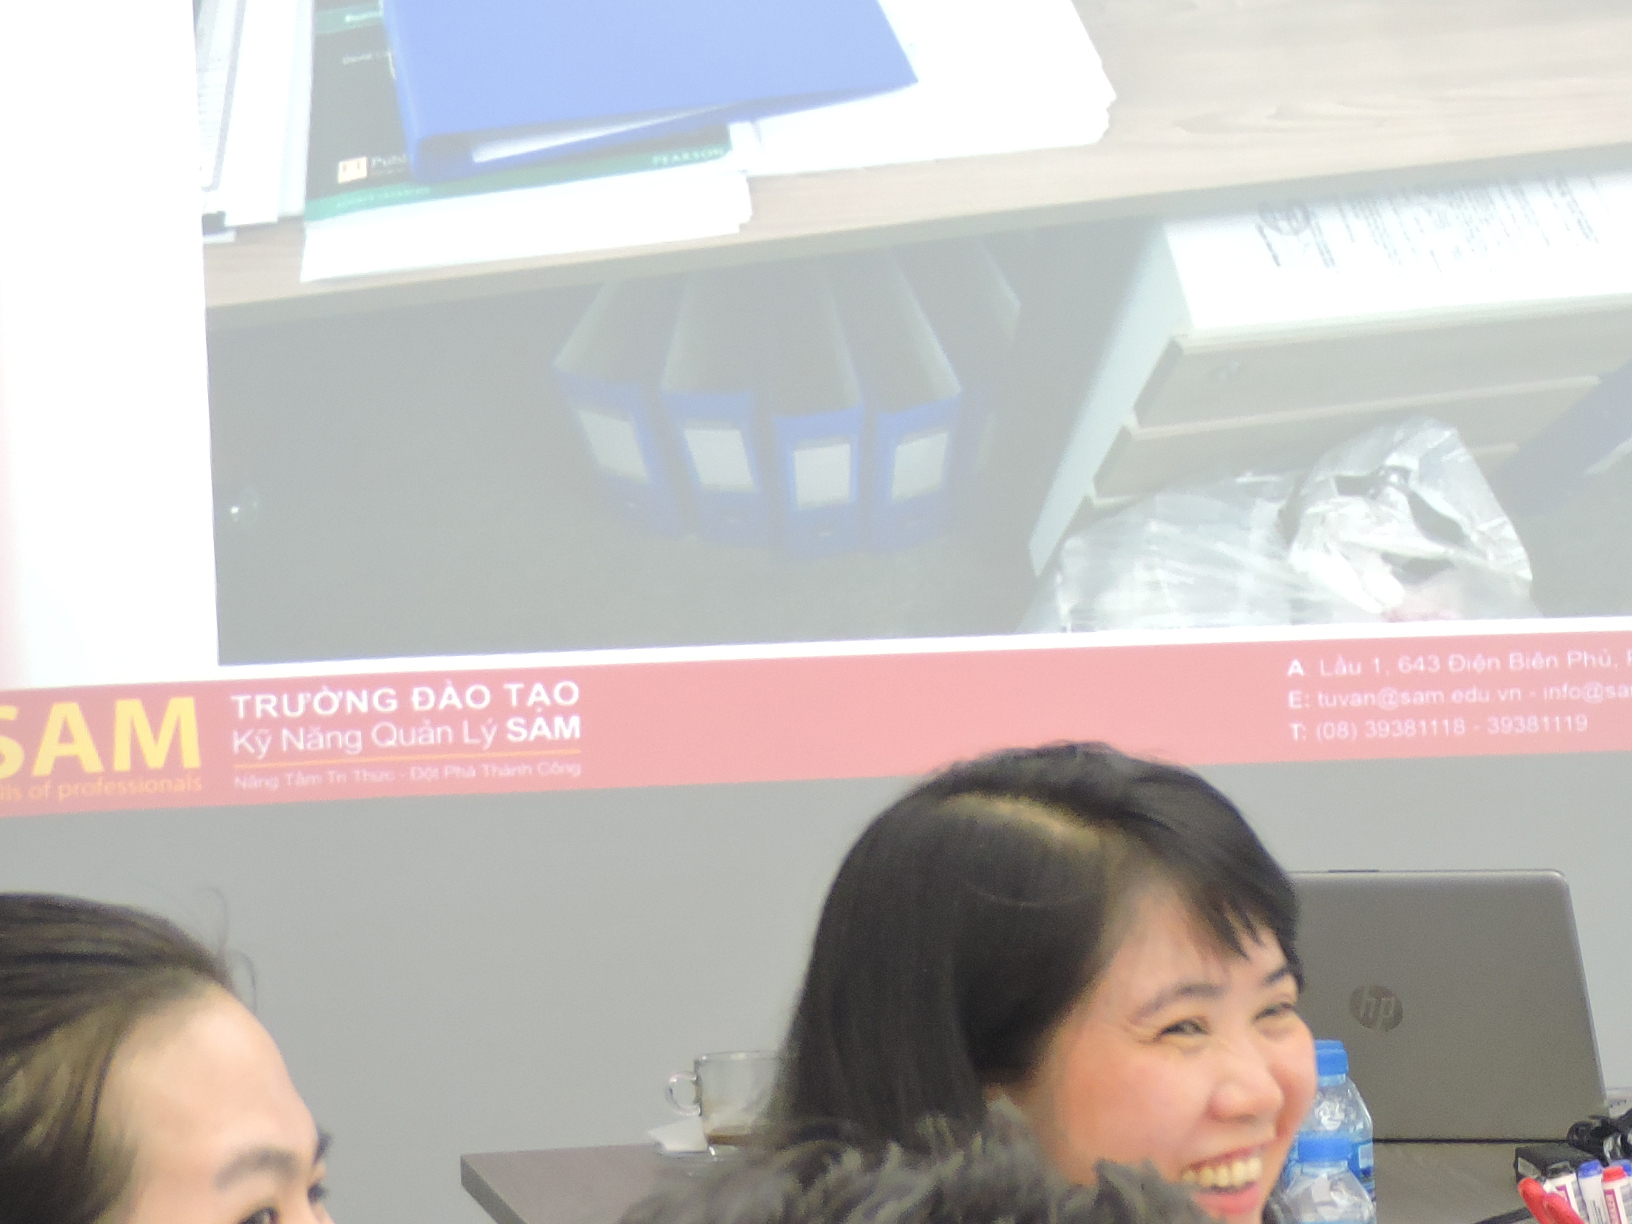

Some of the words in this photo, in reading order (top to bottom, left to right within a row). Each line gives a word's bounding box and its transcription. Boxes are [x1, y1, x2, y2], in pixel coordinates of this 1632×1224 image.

[1397, 653, 1441, 674] 643
[231, 685, 398, 719] TRƯỜNG
[410, 679, 491, 712] ĐÀO
[502, 680, 581, 714] TẠO
[1288, 688, 1310, 709] E:
[231, 728, 273, 761] Kỹ
[281, 724, 363, 755] Năng
[370, 718, 453, 749] Quản
[462, 718, 498, 752] Lý
[505, 714, 582, 743] SAM
[1315, 720, 1358, 744] (08)
[1363, 716, 1467, 739] 39381118
[1486, 713, 1589, 736] 39381119
[57, 773, 202, 801] professionals
[1358, 983, 1397, 1031] hp
